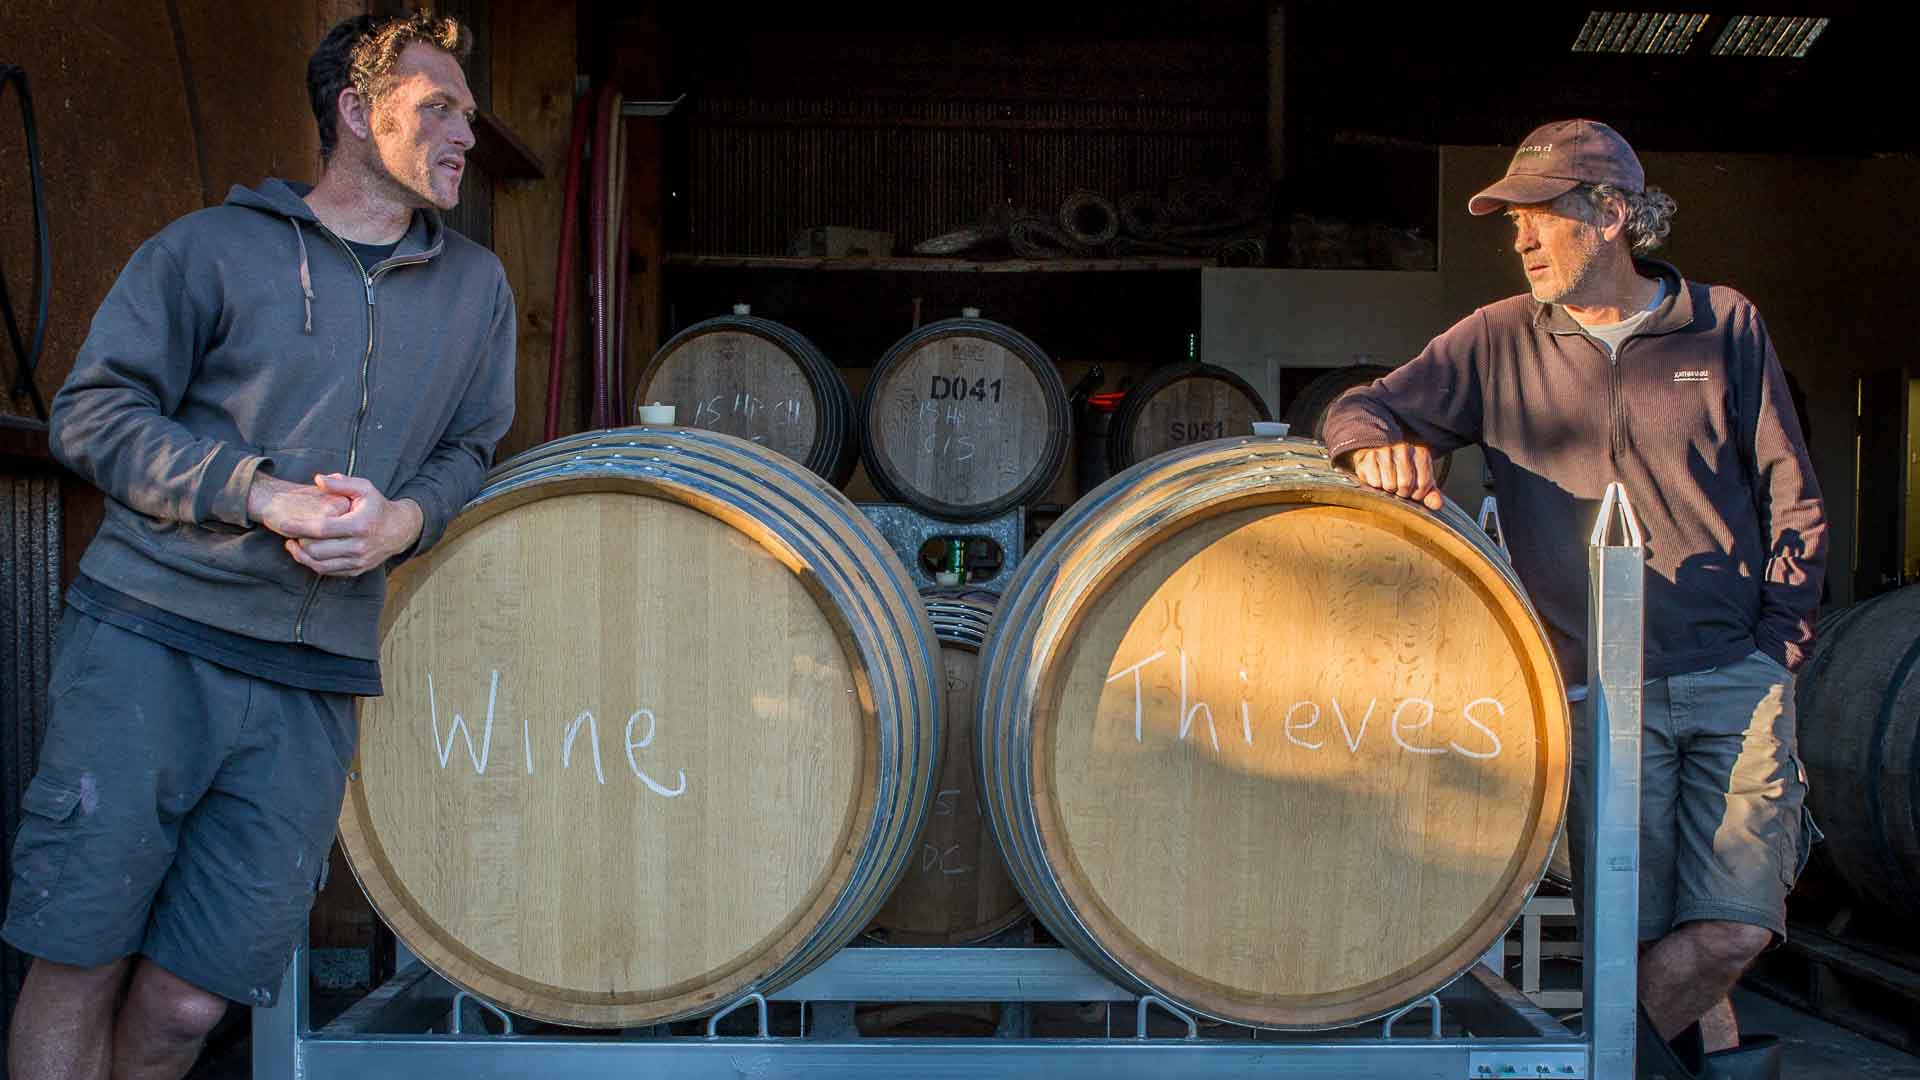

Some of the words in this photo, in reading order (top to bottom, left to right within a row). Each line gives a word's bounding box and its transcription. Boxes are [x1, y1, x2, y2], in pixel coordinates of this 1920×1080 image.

[930, 375, 1002, 403] D041
[1169, 420, 1224, 441] S051
[427, 669, 688, 798] Wine
[1106, 649, 1506, 760] Thieves
